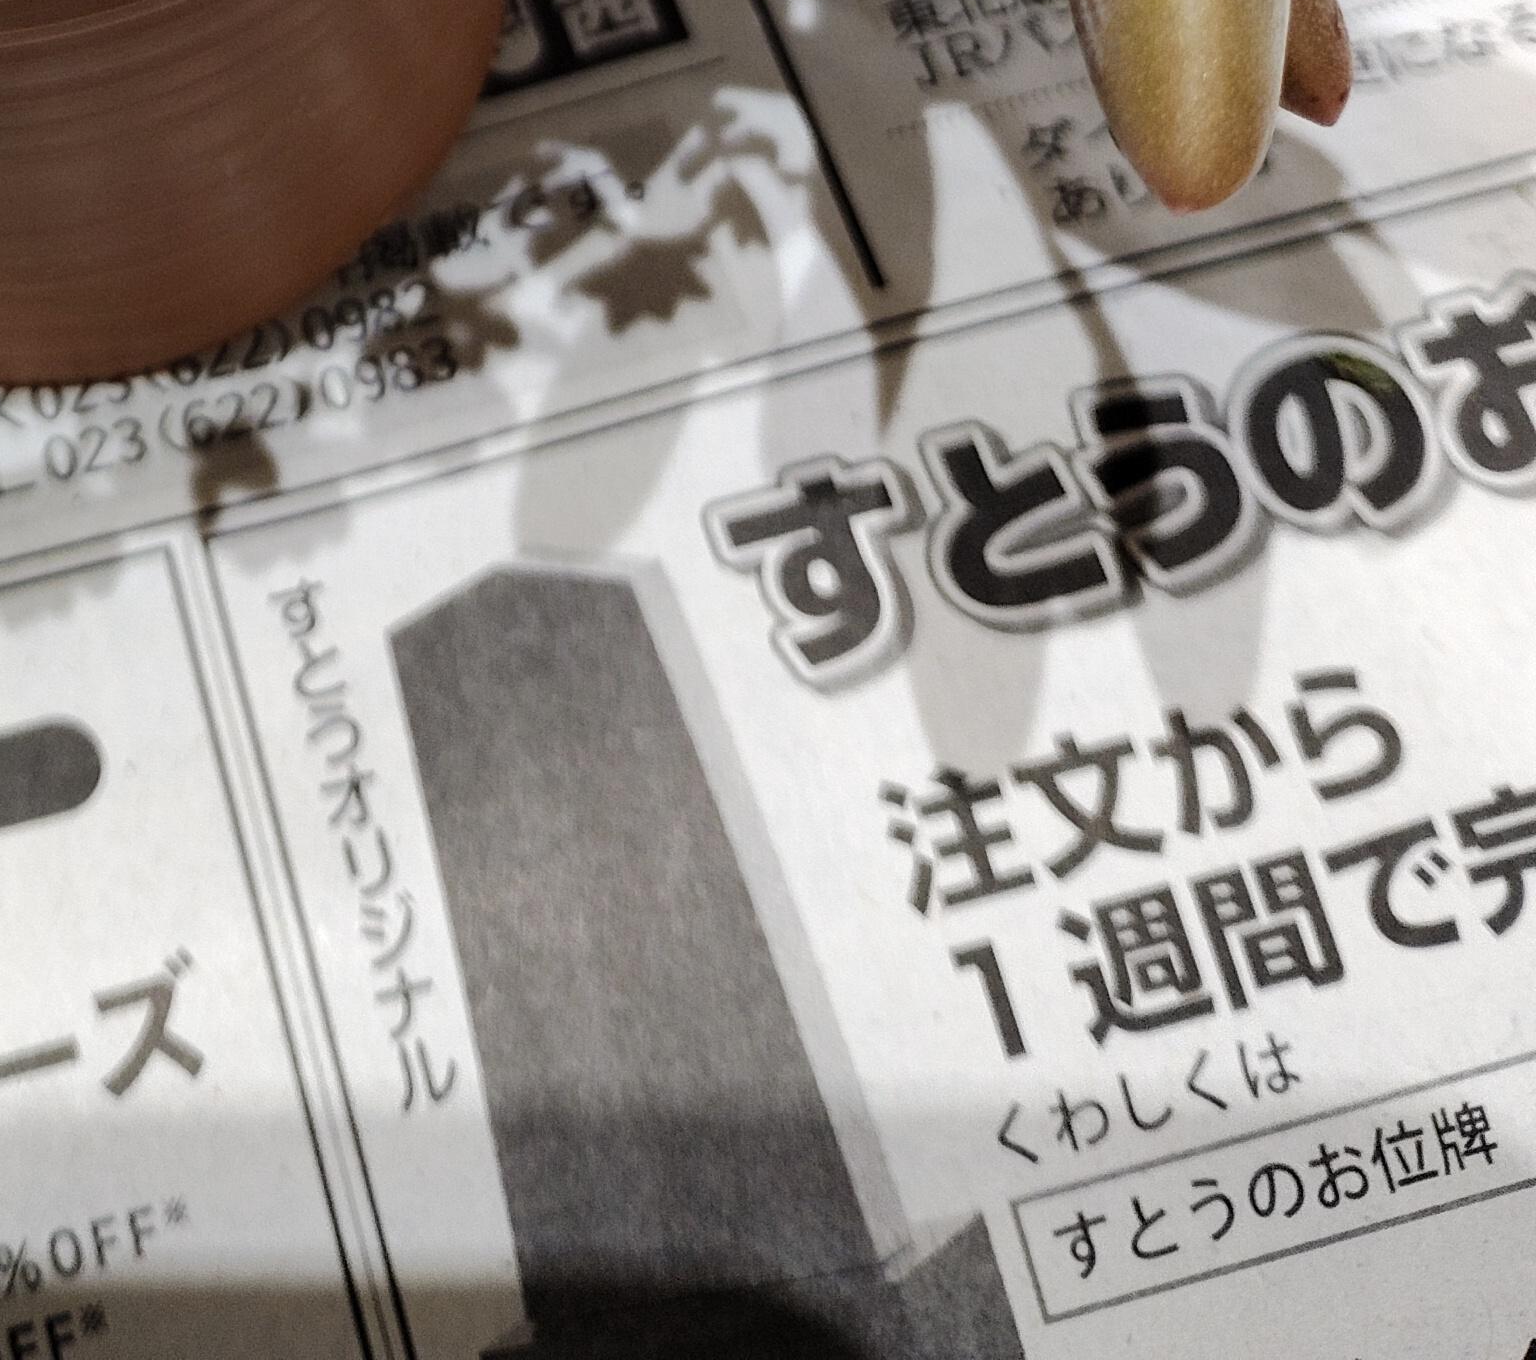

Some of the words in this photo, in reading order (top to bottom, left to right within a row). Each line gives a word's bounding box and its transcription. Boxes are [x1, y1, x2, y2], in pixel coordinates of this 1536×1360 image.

[268, 578, 460, 1114] すとうオリジナル
[877, 666, 1404, 920] 注文から
[996, 1030, 1302, 1165] くわしくは
[1052, 1100, 1500, 1281] すとうのお位牌
